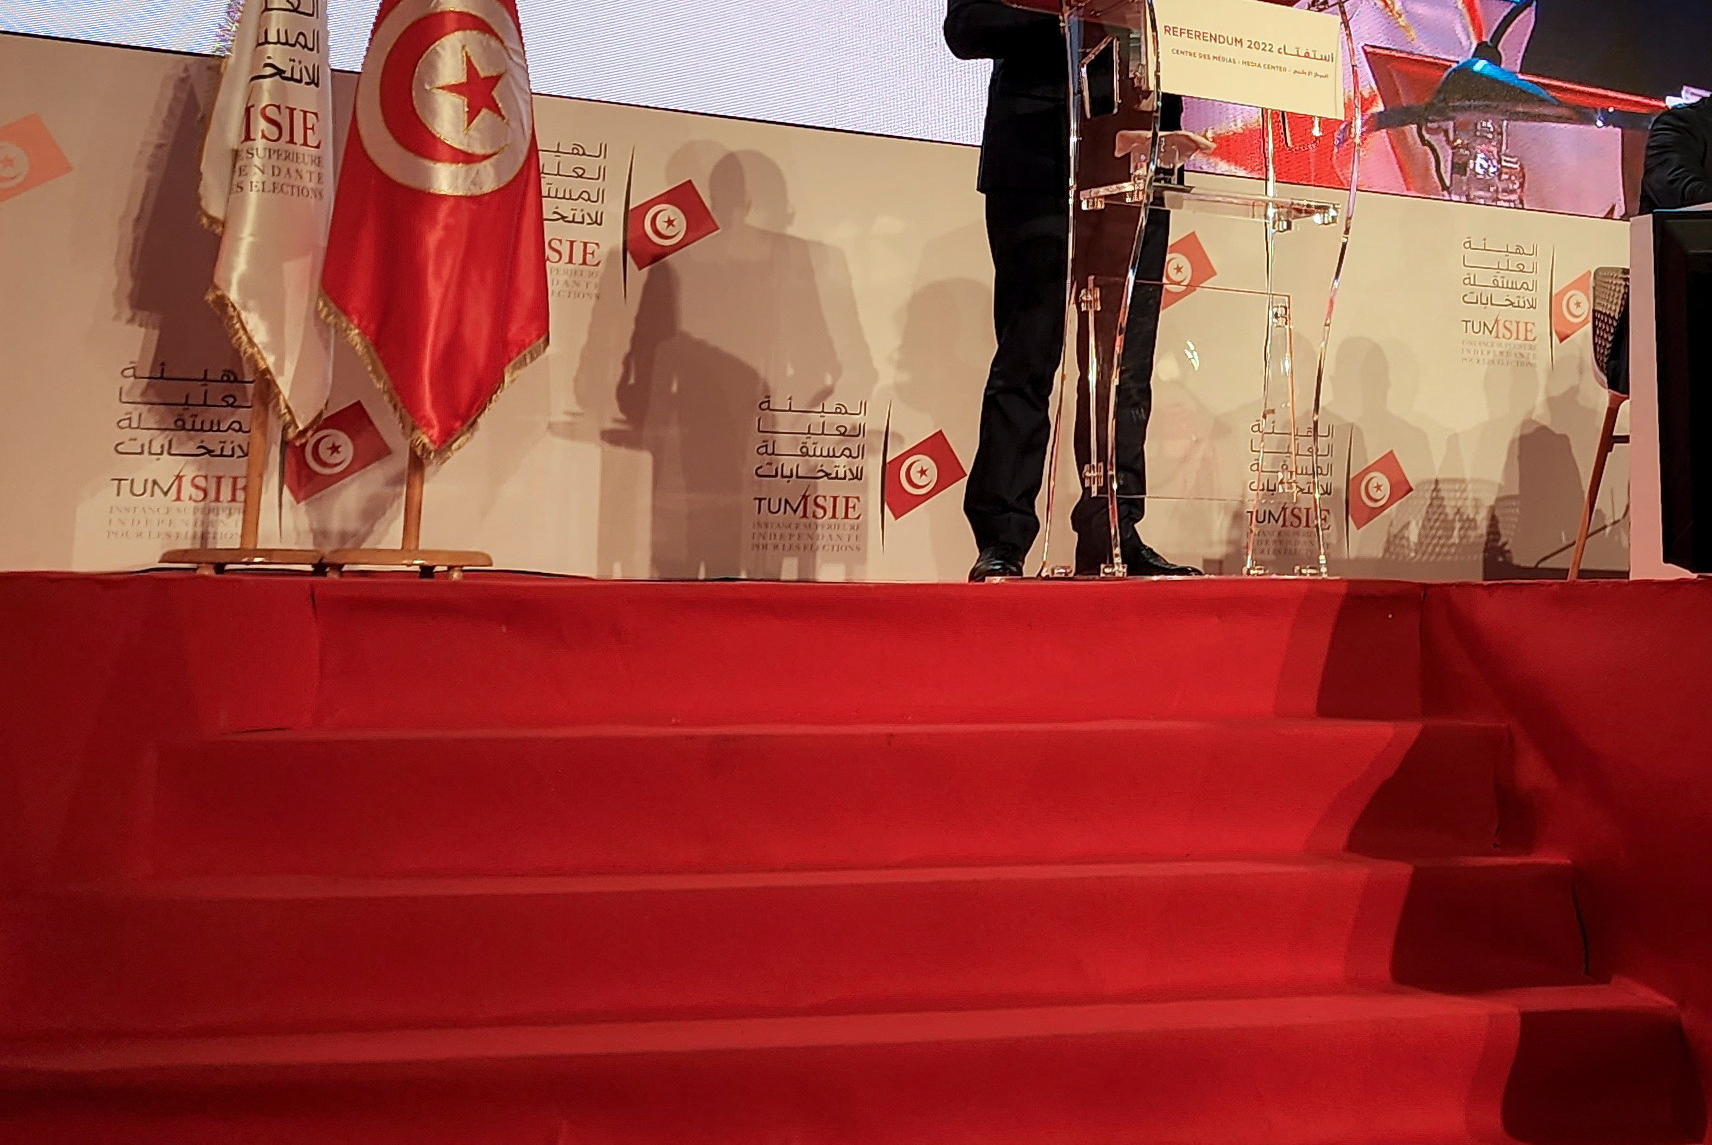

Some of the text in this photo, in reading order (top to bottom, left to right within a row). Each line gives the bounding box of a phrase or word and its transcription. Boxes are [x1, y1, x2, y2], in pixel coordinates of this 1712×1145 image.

[1163, 24, 1334, 63] REFERENDUM 2022 استفتاء
[1171, 48, 1197, 58] CENTRE
[1198, 52, 1211, 61] DES
[250, 56, 320, 88] للانتخ
[241, 103, 322, 149] ISIE
[238, 164, 324, 185] ENDANTE
[1462, 237, 1538, 257] الهيئة
[1462, 254, 1538, 274] العليا
[1462, 273, 1538, 292] المستقلة
[1462, 291, 1537, 310] للانتخابات
[758, 395, 867, 417] الهيئة
[757, 416, 866, 439] العليا
[114, 437, 249, 461] لانتخابات
[756, 439, 865, 460] المستقلة
[754, 462, 864, 483] للانتخابات
